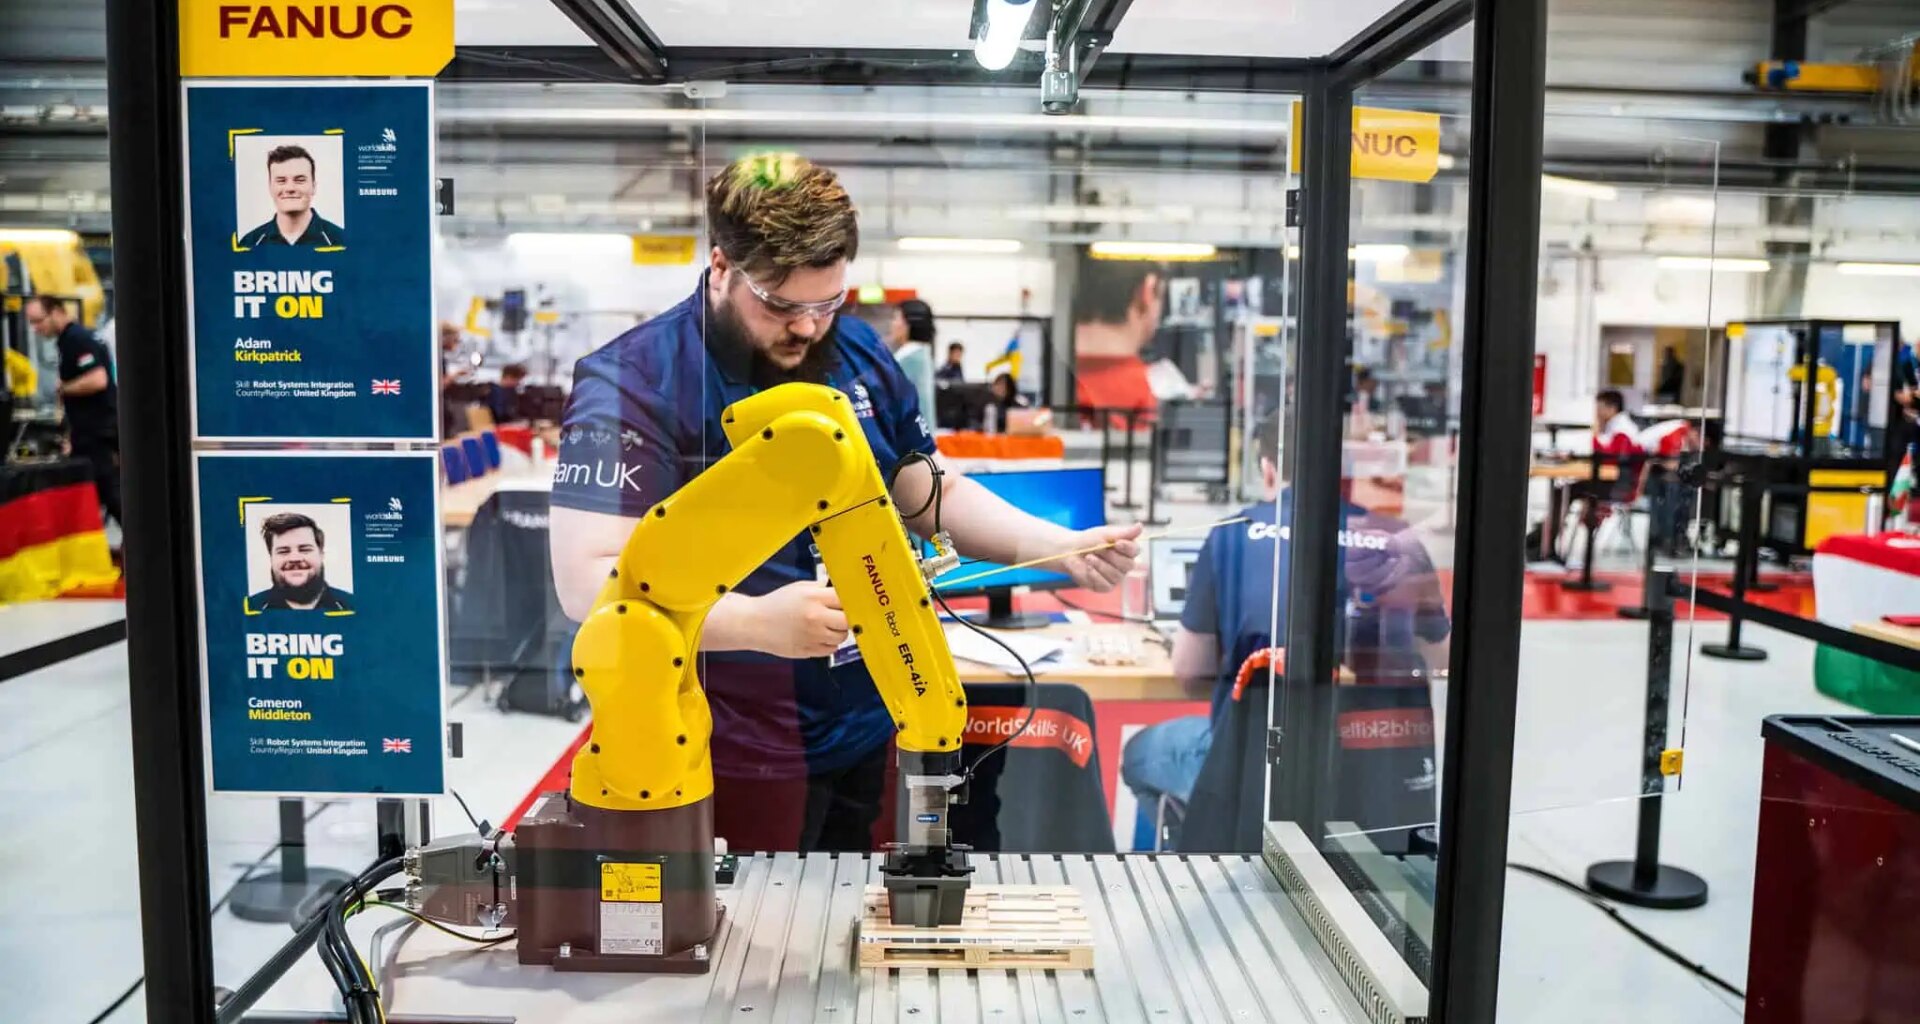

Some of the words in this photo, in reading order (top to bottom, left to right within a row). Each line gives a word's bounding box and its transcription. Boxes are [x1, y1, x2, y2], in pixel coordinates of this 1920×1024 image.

[219, 4, 413, 39] FANUC
[1352, 132, 1417, 158] NUC
[359, 188, 398, 196] SAMSUNG
[233, 270, 334, 294] BRING
[234, 295, 267, 318] IT
[275, 295, 323, 319] ON
[234, 337, 272, 349] Adam
[235, 350, 302, 364] Kirkpatrick
[253, 381, 276, 389] Robot
[278, 381, 309, 391] Systems
[311, 381, 354, 391] Integration
[293, 389, 319, 398] United
[321, 389, 357, 399] Kingdom
[595, 459, 642, 492] UK
[367, 555, 405, 563] SAMSUNG
[862, 554, 890, 607] FANUC
[885, 611, 901, 638] Robot
[898, 643, 928, 697] ER-4iA
[246, 633, 344, 656] BRING
[247, 657, 278, 679] IT
[287, 657, 334, 680] ON
[248, 697, 303, 709] Cameron
[248, 709, 311, 721] Middleton
[266, 738, 289, 746] Robot
[291, 739, 322, 749] Systems
[323, 739, 366, 749] Integration
[1062, 724, 1089, 755] UK
[306, 747, 332, 756] United
[333, 748, 368, 757] Kingdom
